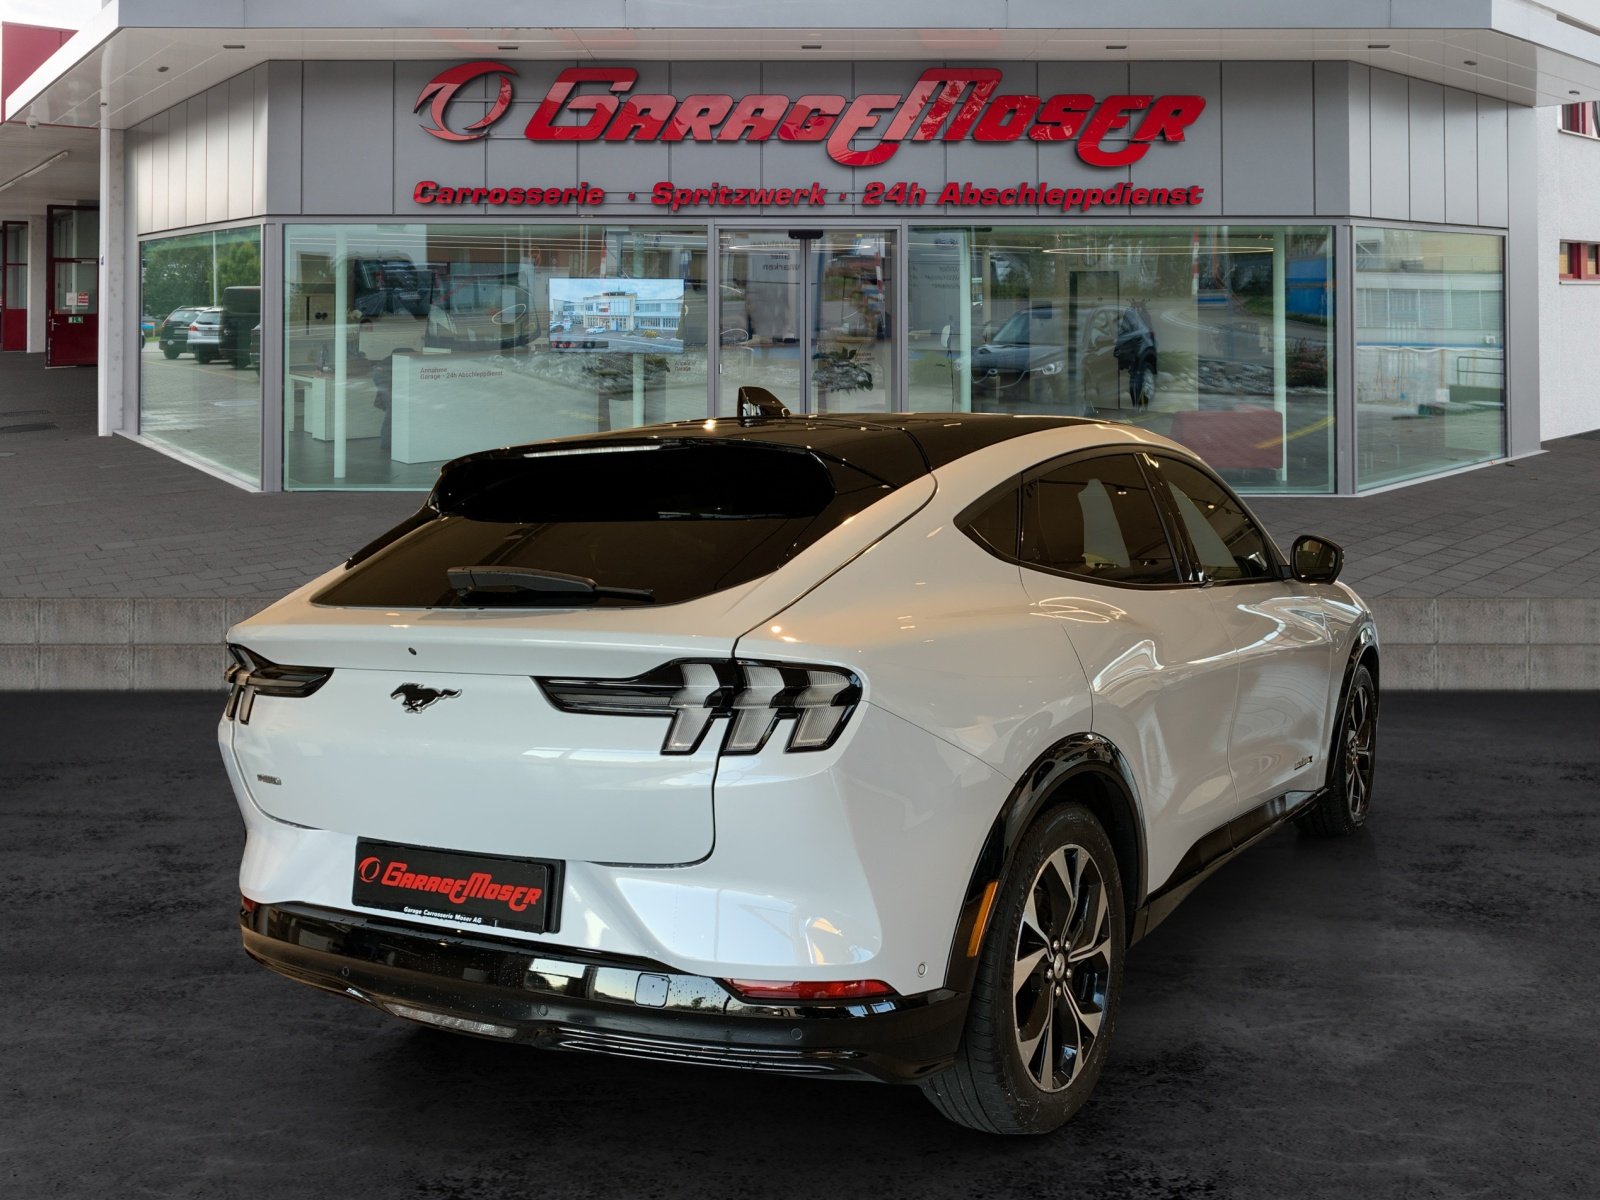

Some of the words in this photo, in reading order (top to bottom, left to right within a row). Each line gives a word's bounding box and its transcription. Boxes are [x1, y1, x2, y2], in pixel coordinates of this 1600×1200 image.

[413, 181, 604, 206] Carrosserie
[651, 181, 826, 211] Spritzwerk
[862, 181, 927, 206] 24h
[936, 181, 1204, 212] Abschleppdienst
[403, 906, 422, 915] Garage
[423, 909, 453, 920] Carrosserie
[454, 914, 472, 922] Moser
